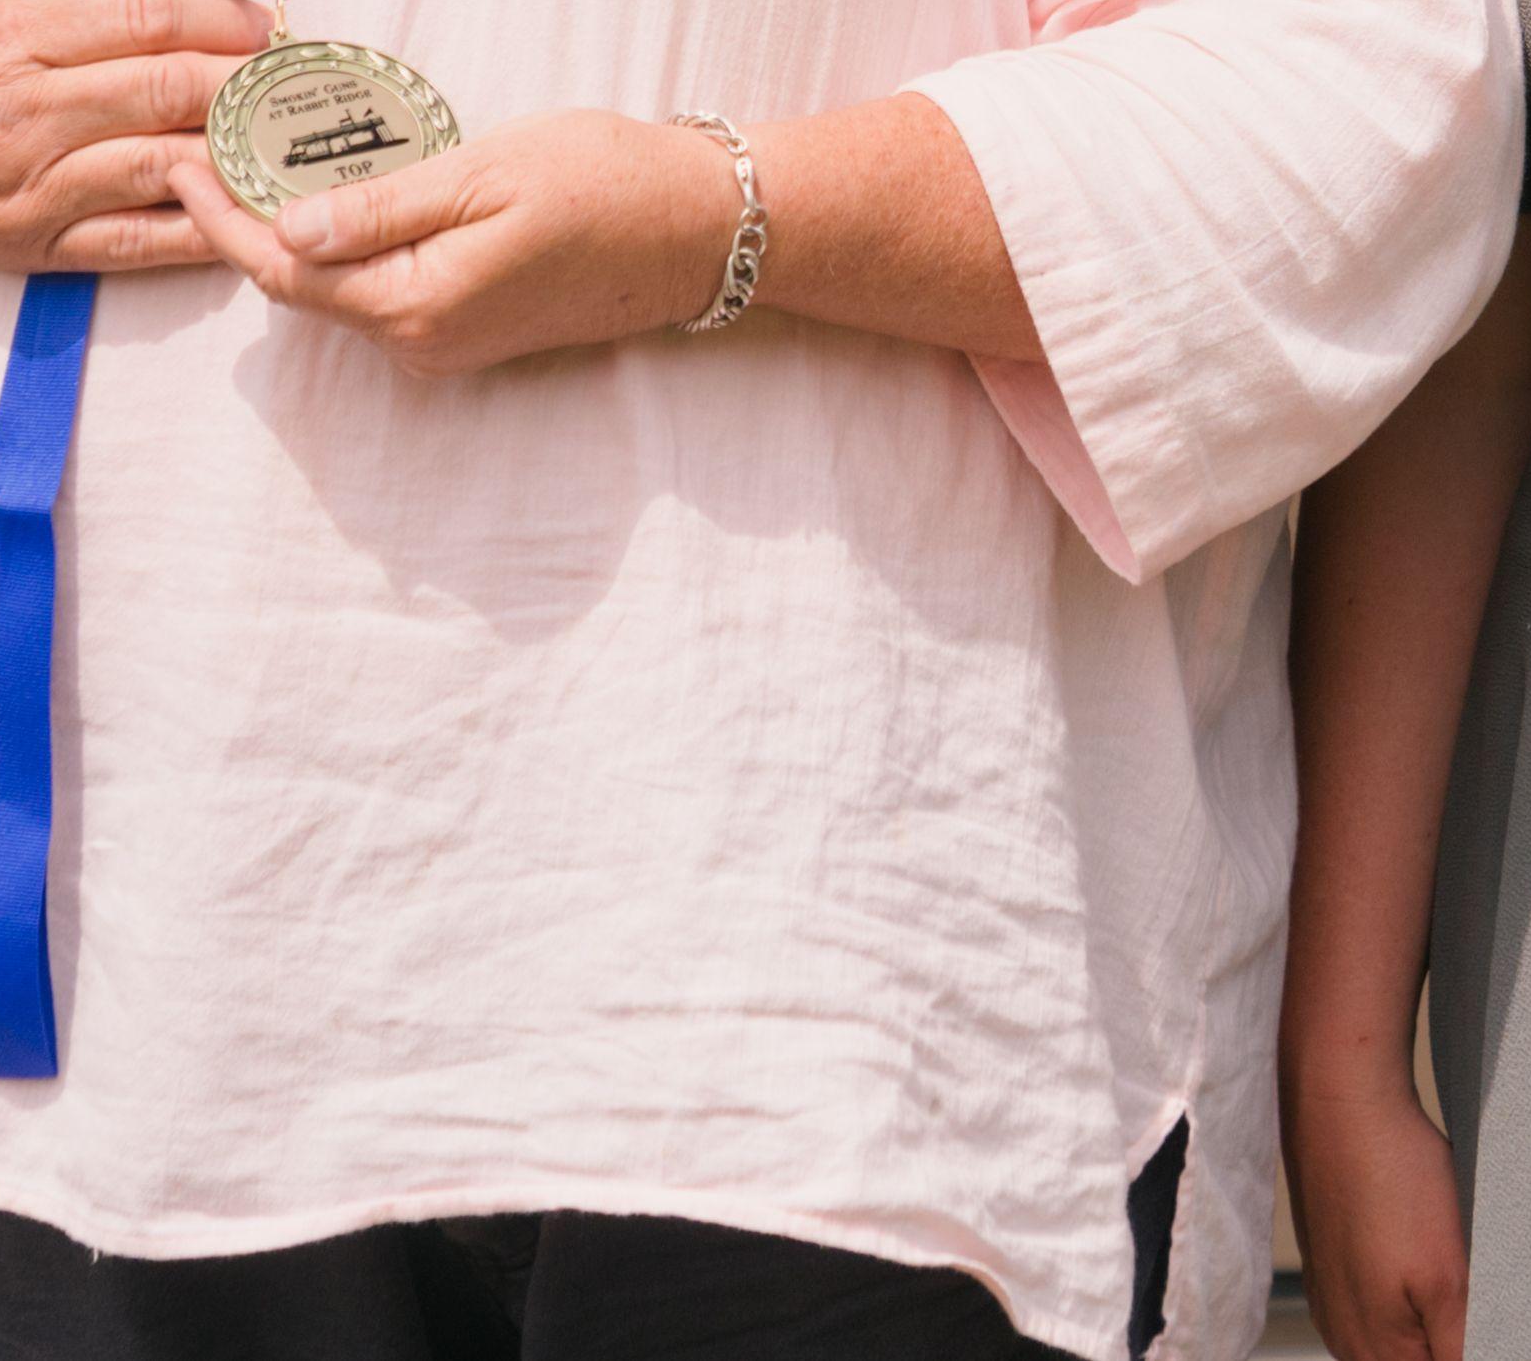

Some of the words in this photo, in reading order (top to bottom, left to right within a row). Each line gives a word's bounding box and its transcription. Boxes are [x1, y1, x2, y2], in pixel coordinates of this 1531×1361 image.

[323, 80, 358, 94] GUNS
[287, 99, 330, 116] RABBIT
[333, 89, 373, 105] RIDGE
[335, 160, 373, 181] TOP
